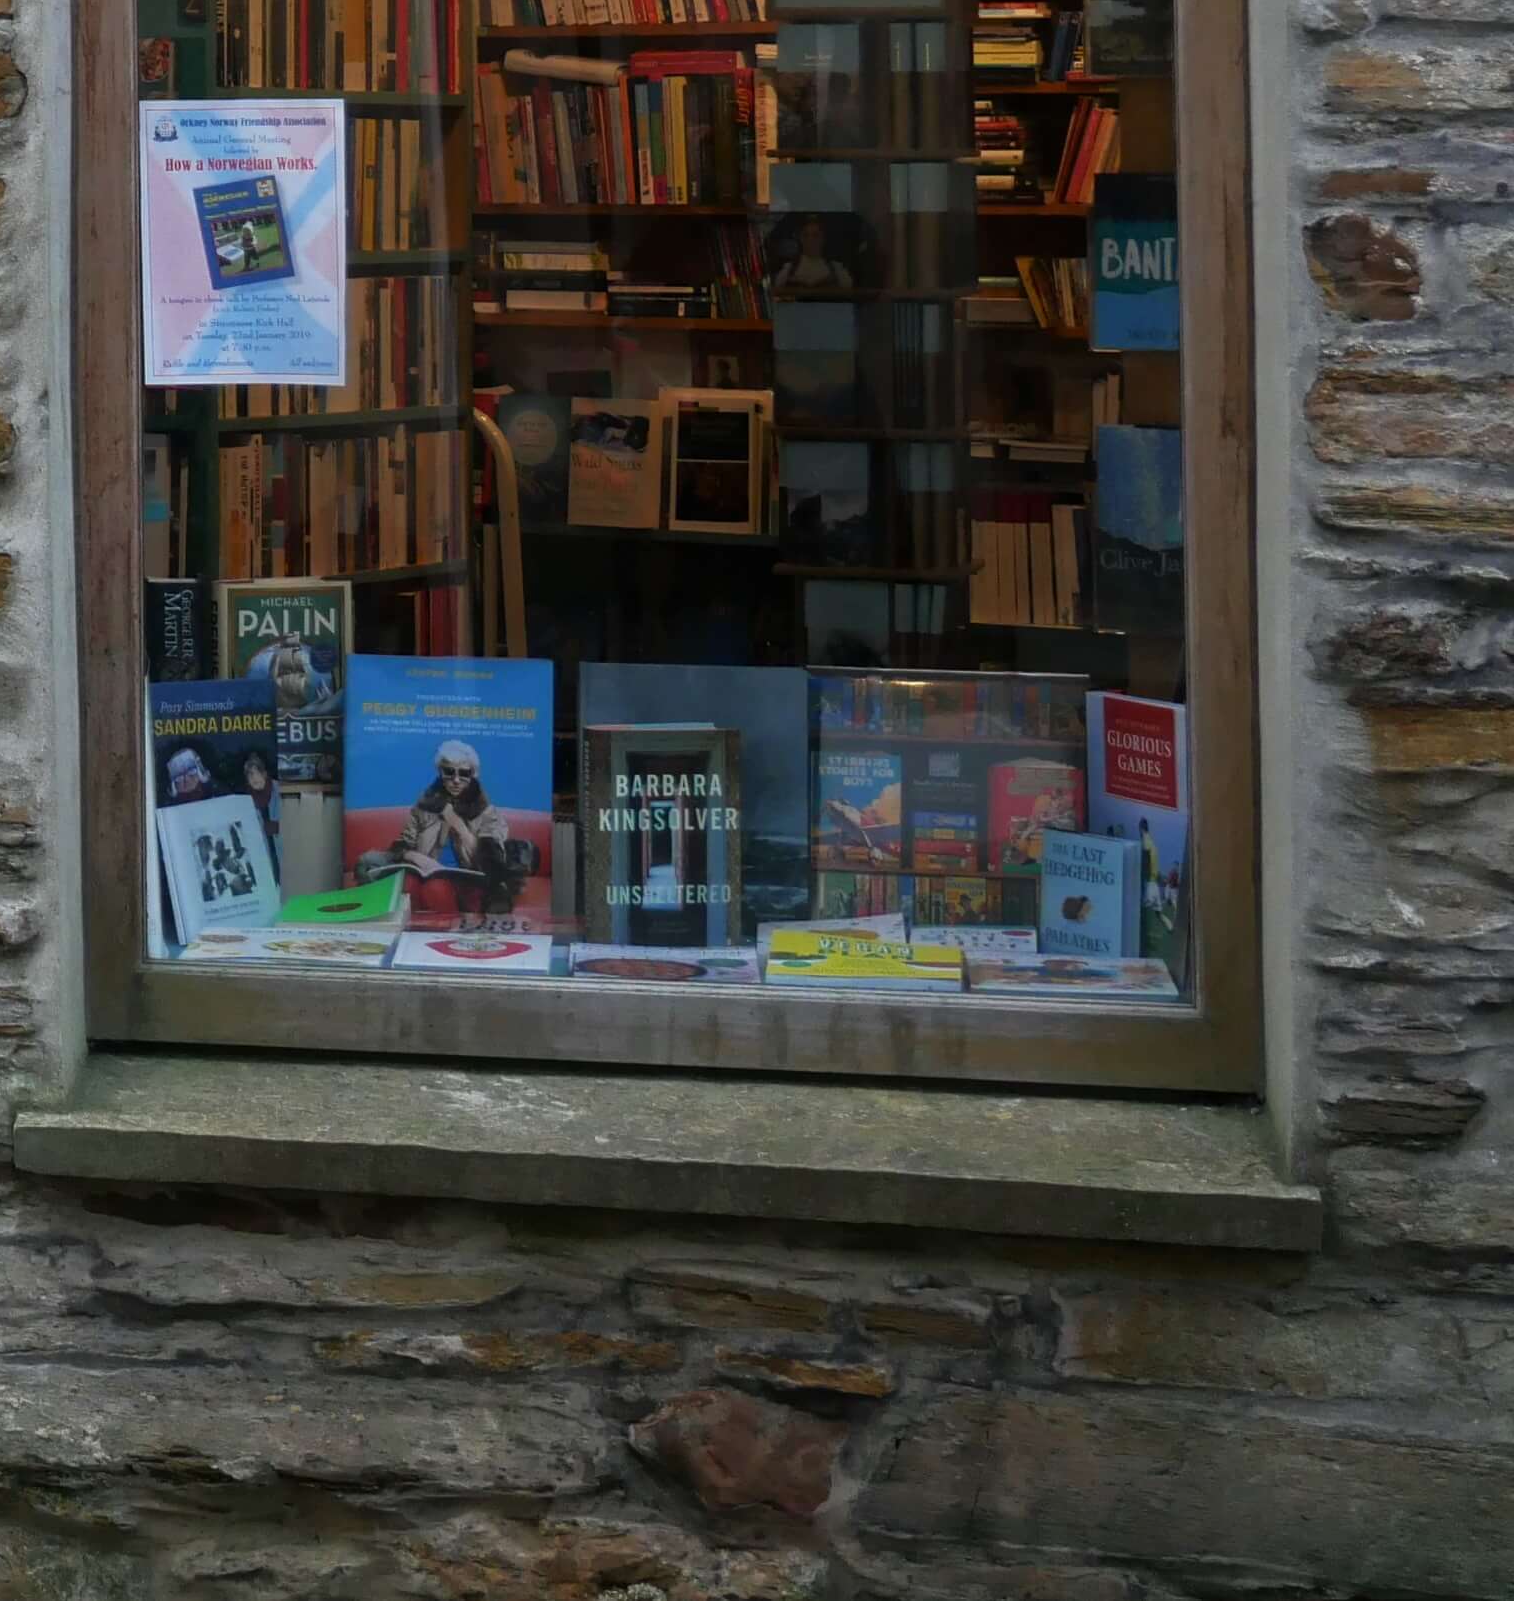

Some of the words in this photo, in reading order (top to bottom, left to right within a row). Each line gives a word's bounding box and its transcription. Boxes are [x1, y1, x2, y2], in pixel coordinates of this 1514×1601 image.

[179, 118, 208, 128] Orkney
[210, 118, 238, 128] Norway
[240, 117, 282, 128] Friendship
[283, 117, 327, 127] Association
[164, 158, 191, 172] How
[196, 160, 204, 171] a
[207, 157, 273, 172] Norwegian
[276, 155, 318, 171] Works.
[1100, 548, 1153, 572] Clive
[182, 589, 194, 636] GEORGE
[260, 597, 314, 608] MICHAEL
[163, 592, 182, 658] MARTIN
[238, 607, 337, 638] PALIN
[362, 702, 417, 717] PEGGY
[423, 704, 537, 720] GUGGENHEIM
[154, 716, 219, 736] SANDRA
[221, 714, 272, 733] DARKE
[1107, 729, 1172, 758] GLORIOUS
[872, 767, 895, 778] FOR
[1117, 753, 1162, 778] GAMES
[615, 773, 723, 798] BARBARA
[842, 777, 874, 787] BOYS
[598, 807, 739, 833] KINGSOLVER
[1072, 844, 1107, 866] LAST
[1044, 857, 1116, 887] HEDGEHOG
[606, 883, 732, 906] UNSHELTERED
